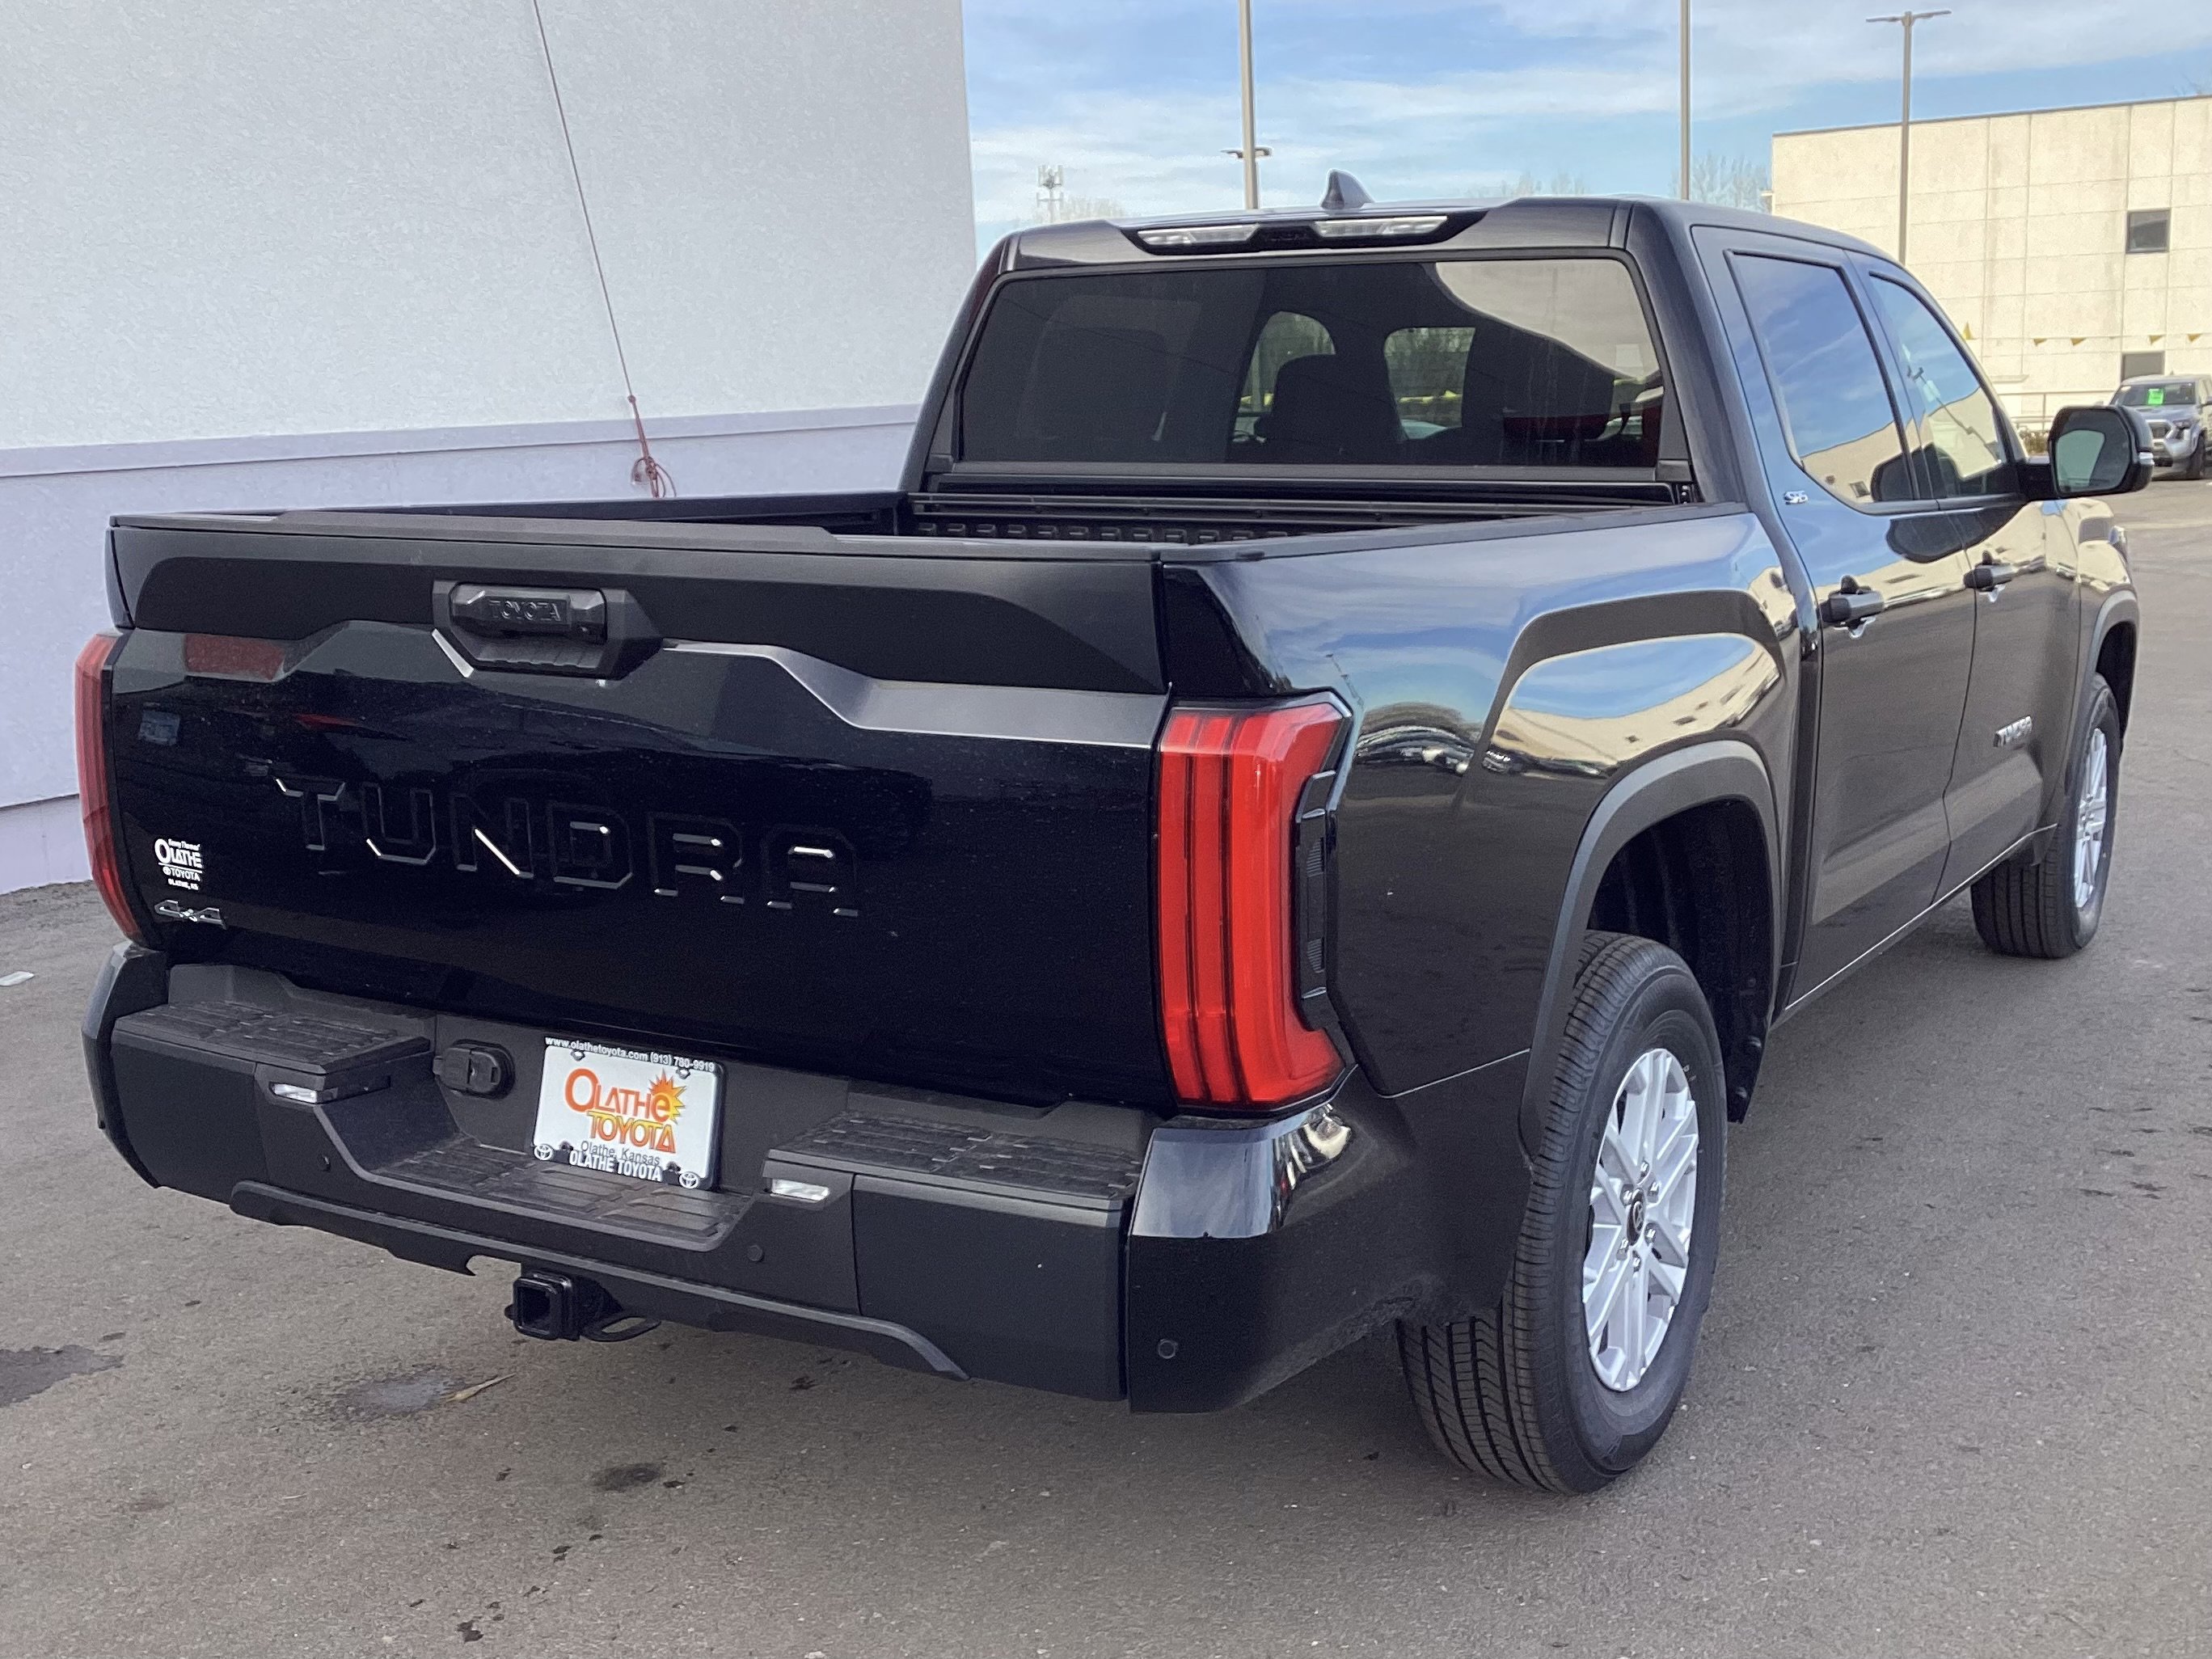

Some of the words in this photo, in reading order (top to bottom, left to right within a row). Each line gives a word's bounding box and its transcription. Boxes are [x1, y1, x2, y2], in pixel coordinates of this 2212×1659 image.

[154, 838, 203, 868] OLATHE
[275, 772, 860, 918] TUNDRA
[170, 867, 201, 882] TOYOTA
[545, 1036, 648, 1062] www.olathetoyota.com
[650, 1051, 673, 1065] (913)
[586, 1110, 677, 1155] TOYOTA
[568, 1150, 616, 1173] OLATHE
[617, 1157, 663, 1183] TOYOTA
[620, 1146, 661, 1166] Kansas
